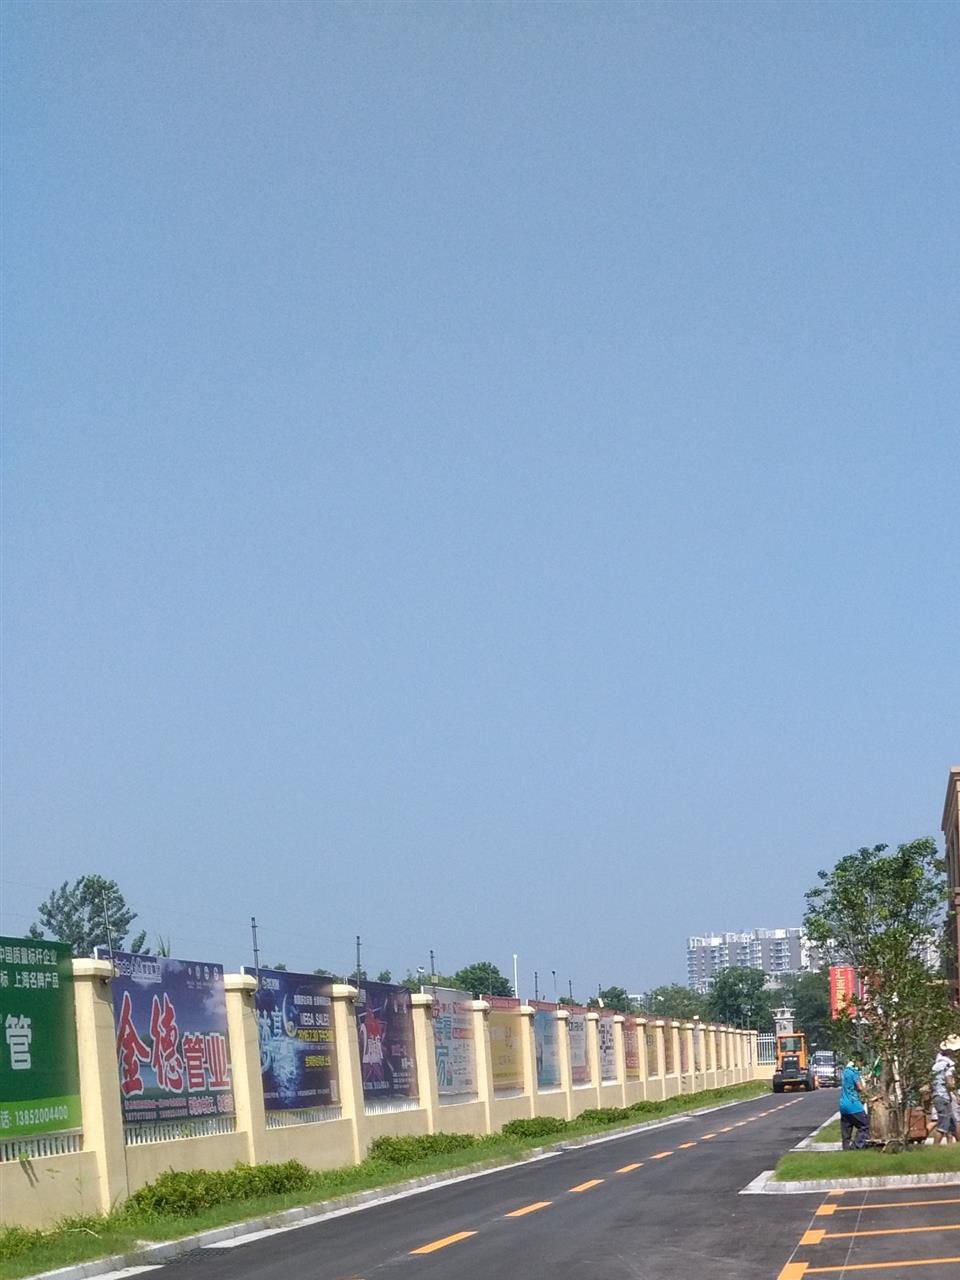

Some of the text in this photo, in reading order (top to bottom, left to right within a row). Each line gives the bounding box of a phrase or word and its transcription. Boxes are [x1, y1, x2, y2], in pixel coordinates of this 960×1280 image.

[14, 971, 59, 989] 上海名牌产品
[5, 1013, 32, 1070] 管
